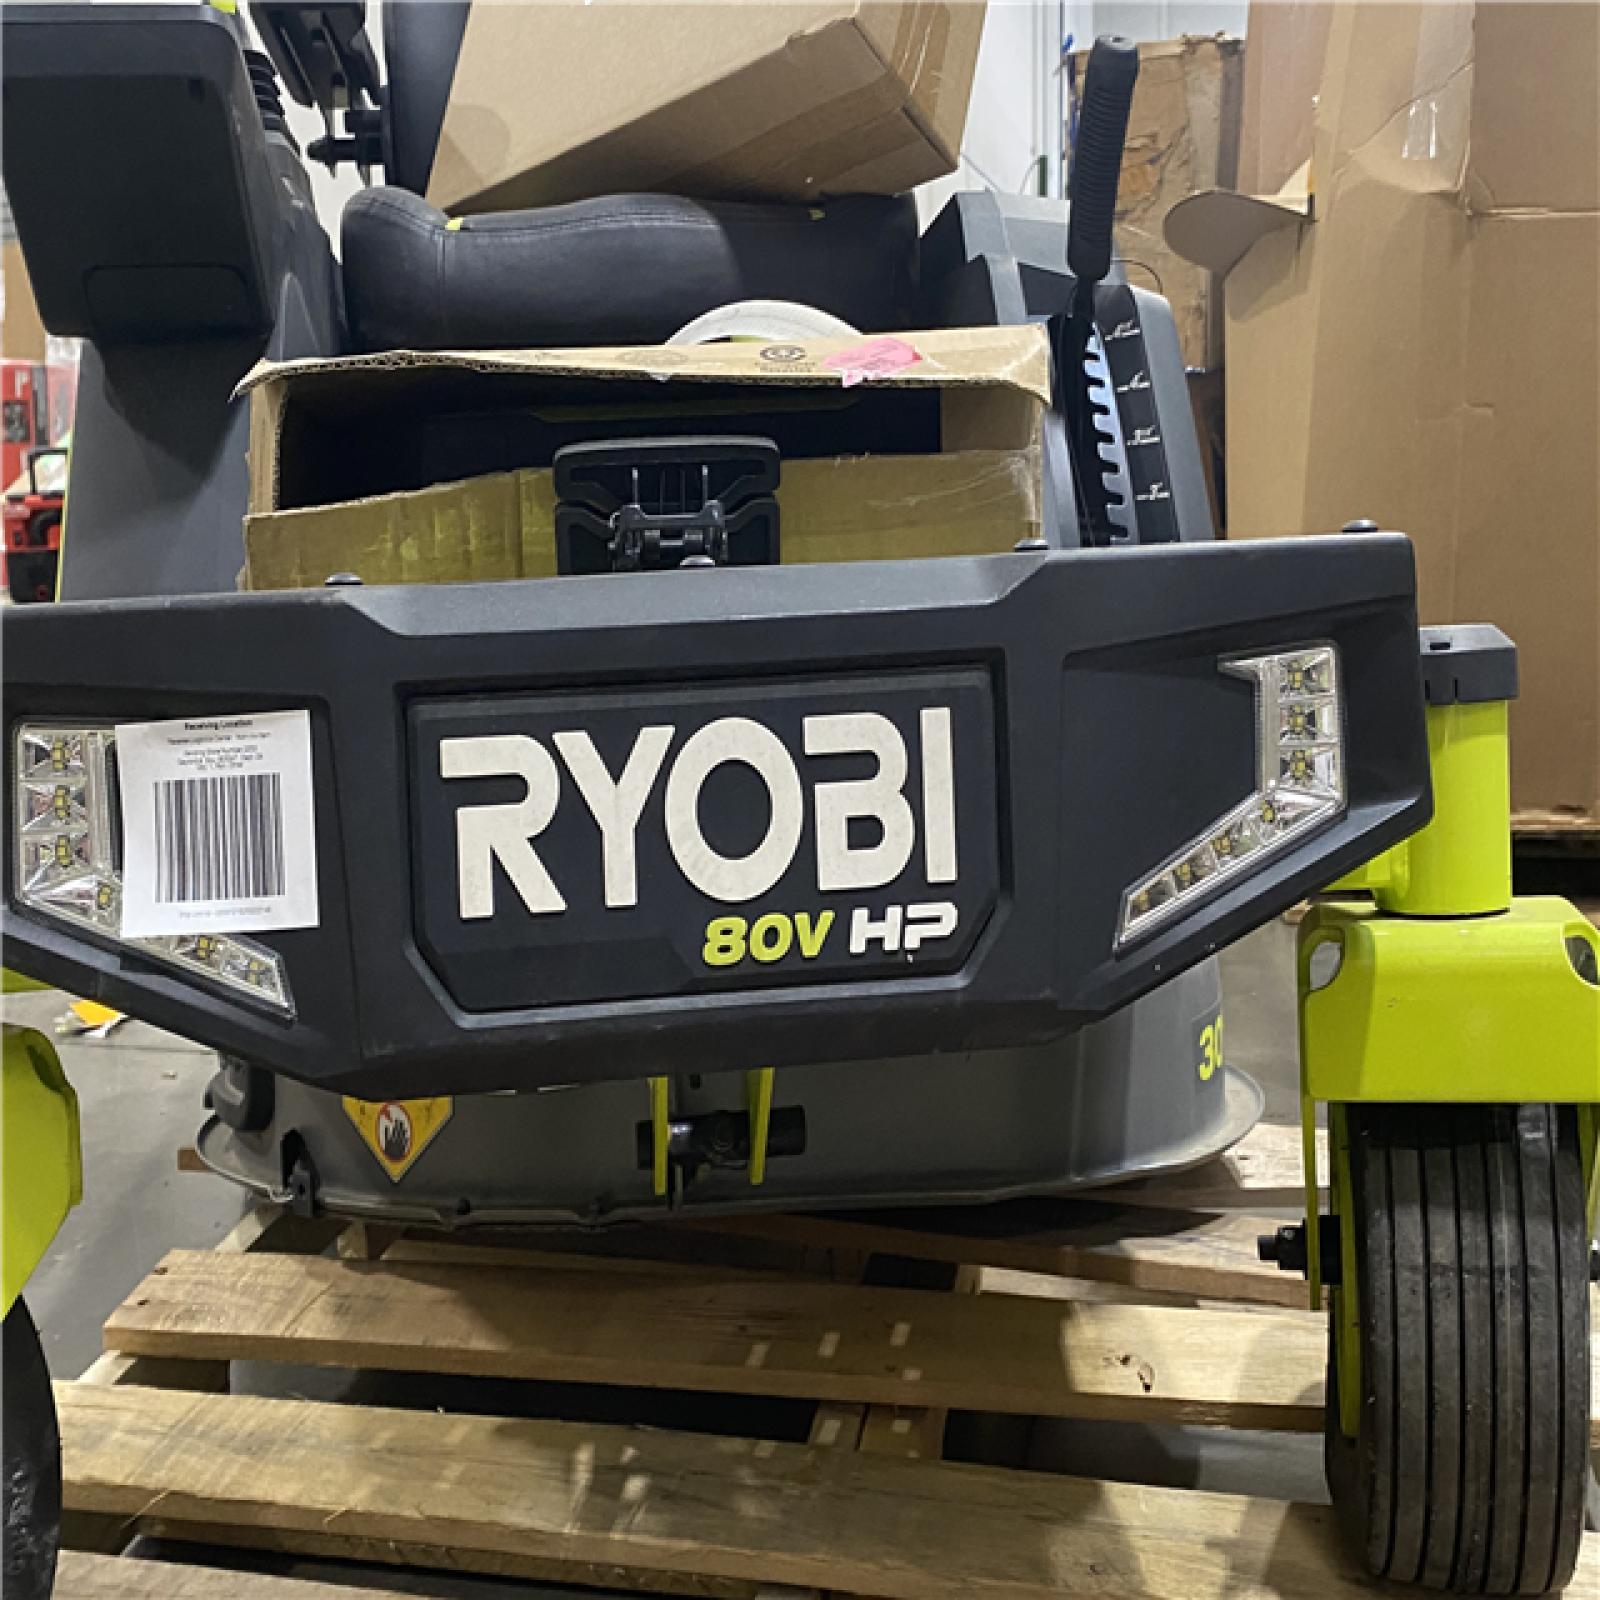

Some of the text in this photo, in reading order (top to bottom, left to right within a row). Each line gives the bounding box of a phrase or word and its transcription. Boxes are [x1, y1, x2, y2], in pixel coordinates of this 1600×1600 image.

[439, 706, 958, 919] RYOBI
[702, 902, 959, 966] 80V HP
